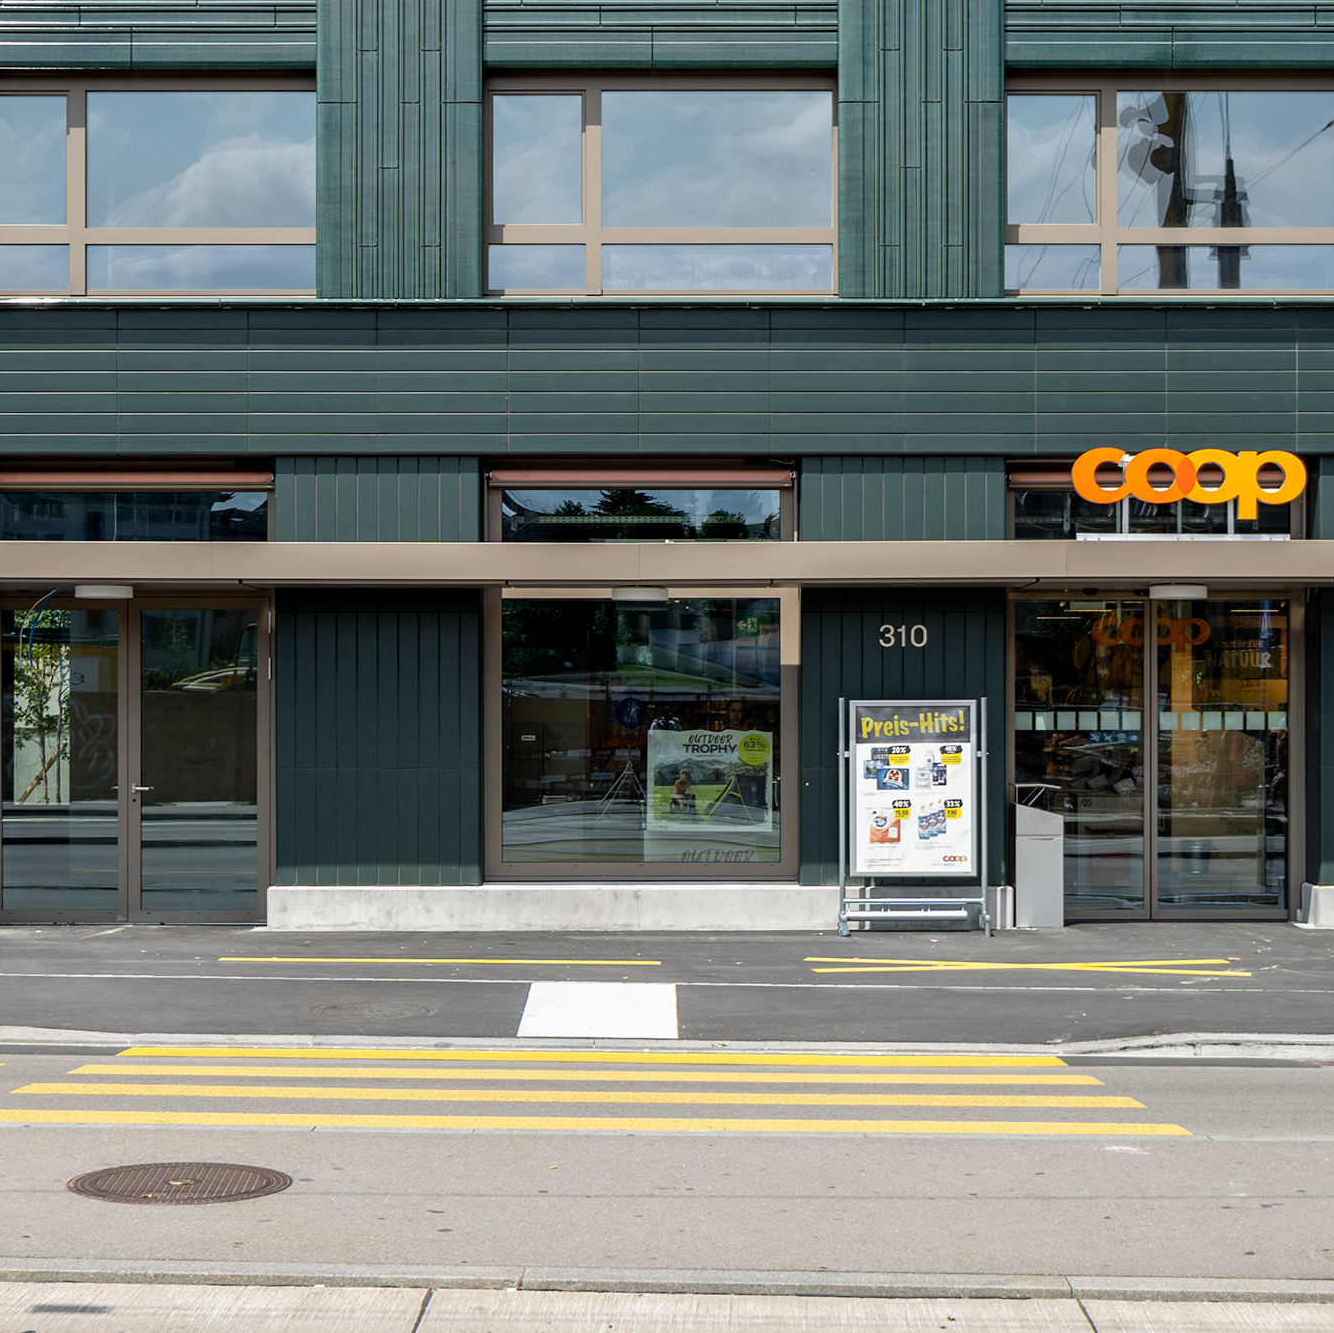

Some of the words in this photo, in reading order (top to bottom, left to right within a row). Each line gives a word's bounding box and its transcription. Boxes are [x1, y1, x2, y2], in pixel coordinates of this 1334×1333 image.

[1071, 447, 1307, 519] coop
[878, 624, 928, 647] 310
[1091, 617, 1211, 653] coop
[1247, 639, 1264, 648] ZUR
[860, 710, 965, 738] Preis-Hits!
[688, 734, 734, 745] OUTDOOR
[682, 744, 738, 753] TROPHY
[743, 741, 766, 749] 63%
[891, 746, 907, 754] 20%
[1081, 798, 1092, 807] 05
[943, 855, 968, 863] coop
